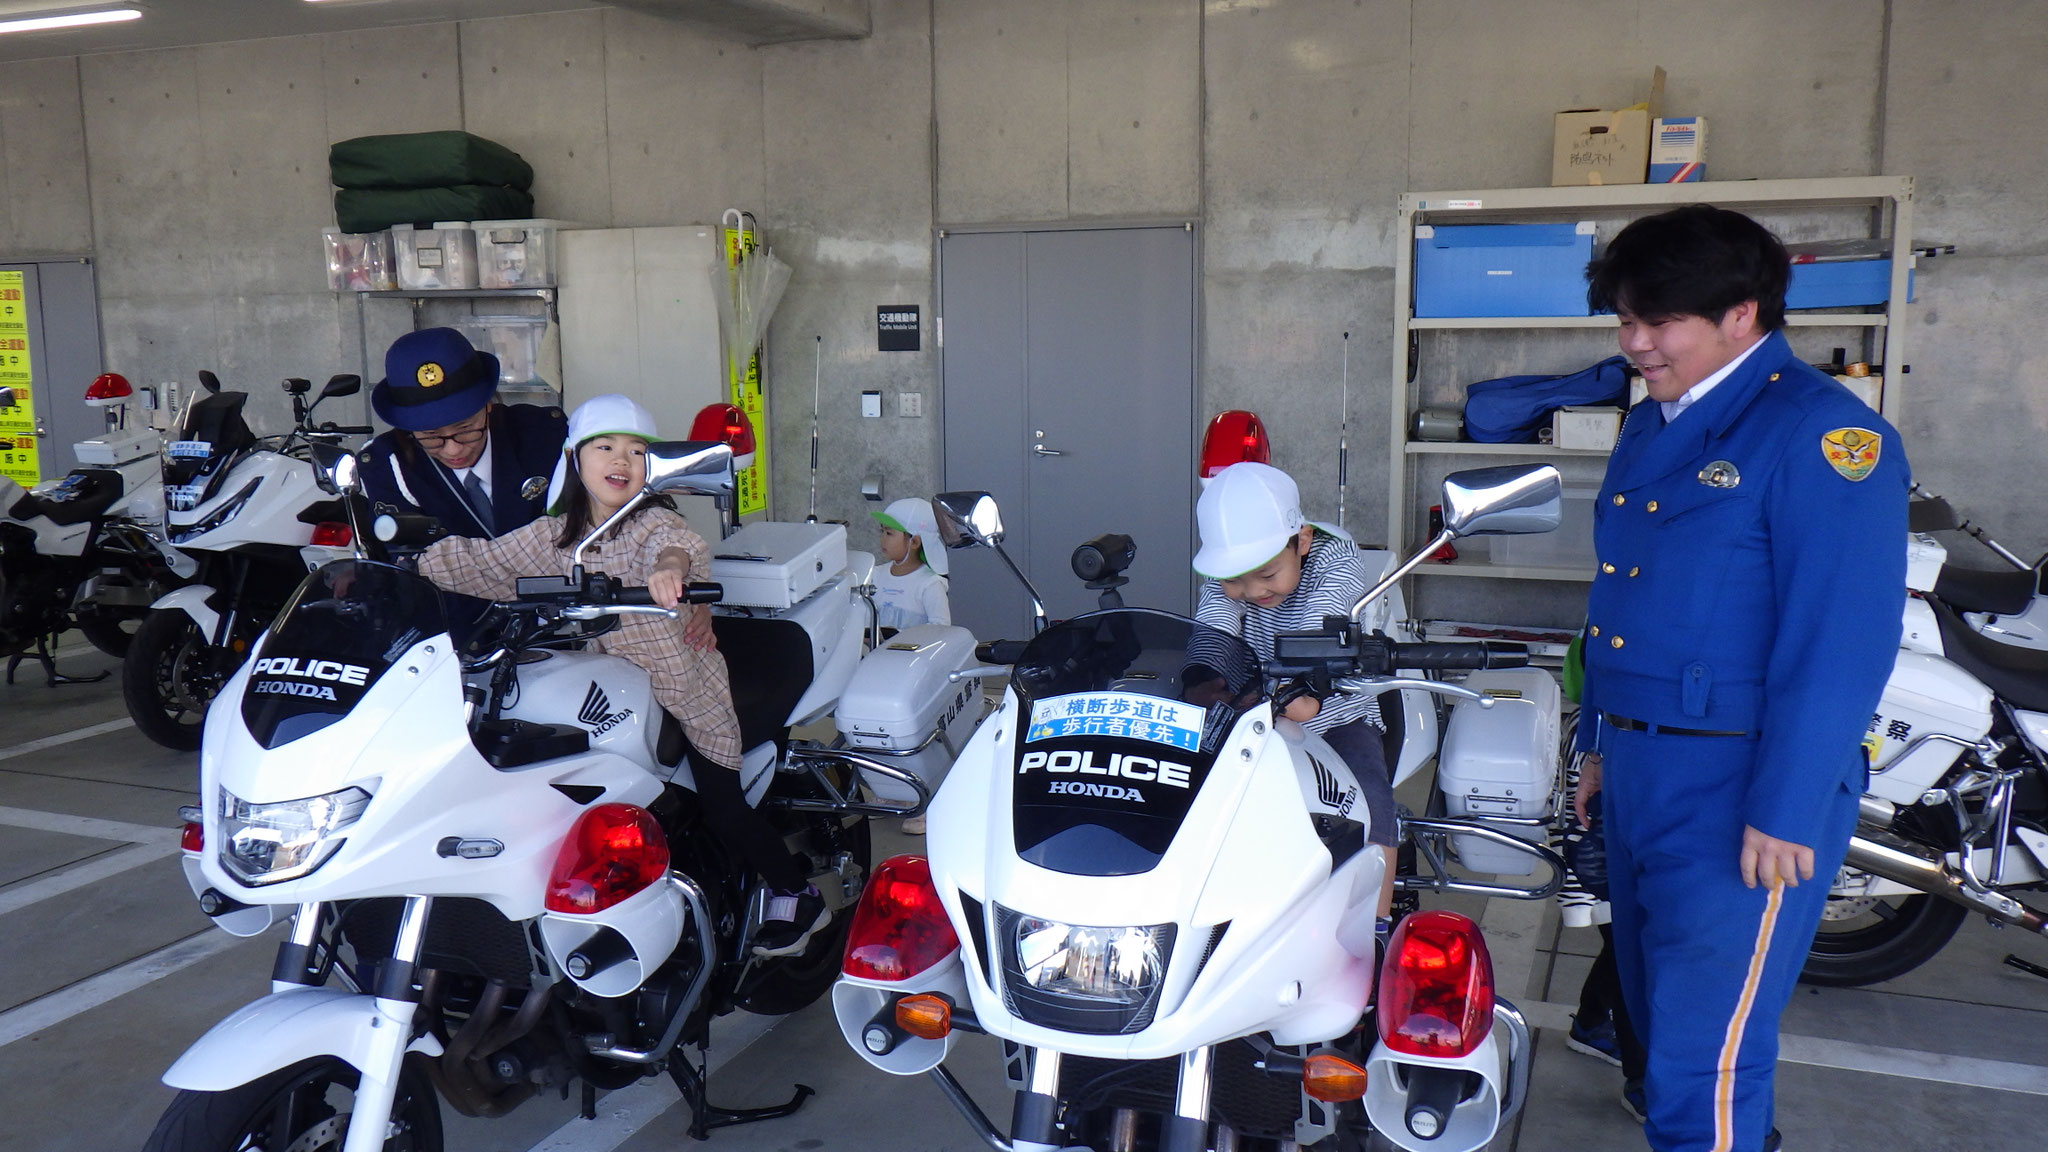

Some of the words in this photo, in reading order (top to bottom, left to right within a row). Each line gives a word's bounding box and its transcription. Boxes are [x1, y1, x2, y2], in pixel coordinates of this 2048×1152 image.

[252, 657, 370, 687] POLICE
[254, 681, 338, 701] HONDA
[590, 708, 634, 738] HONDA
[1065, 697, 1179, 724] 横断歩道は
[1019, 751, 1192, 789] POLICE
[1048, 781, 1146, 803] HONDA
